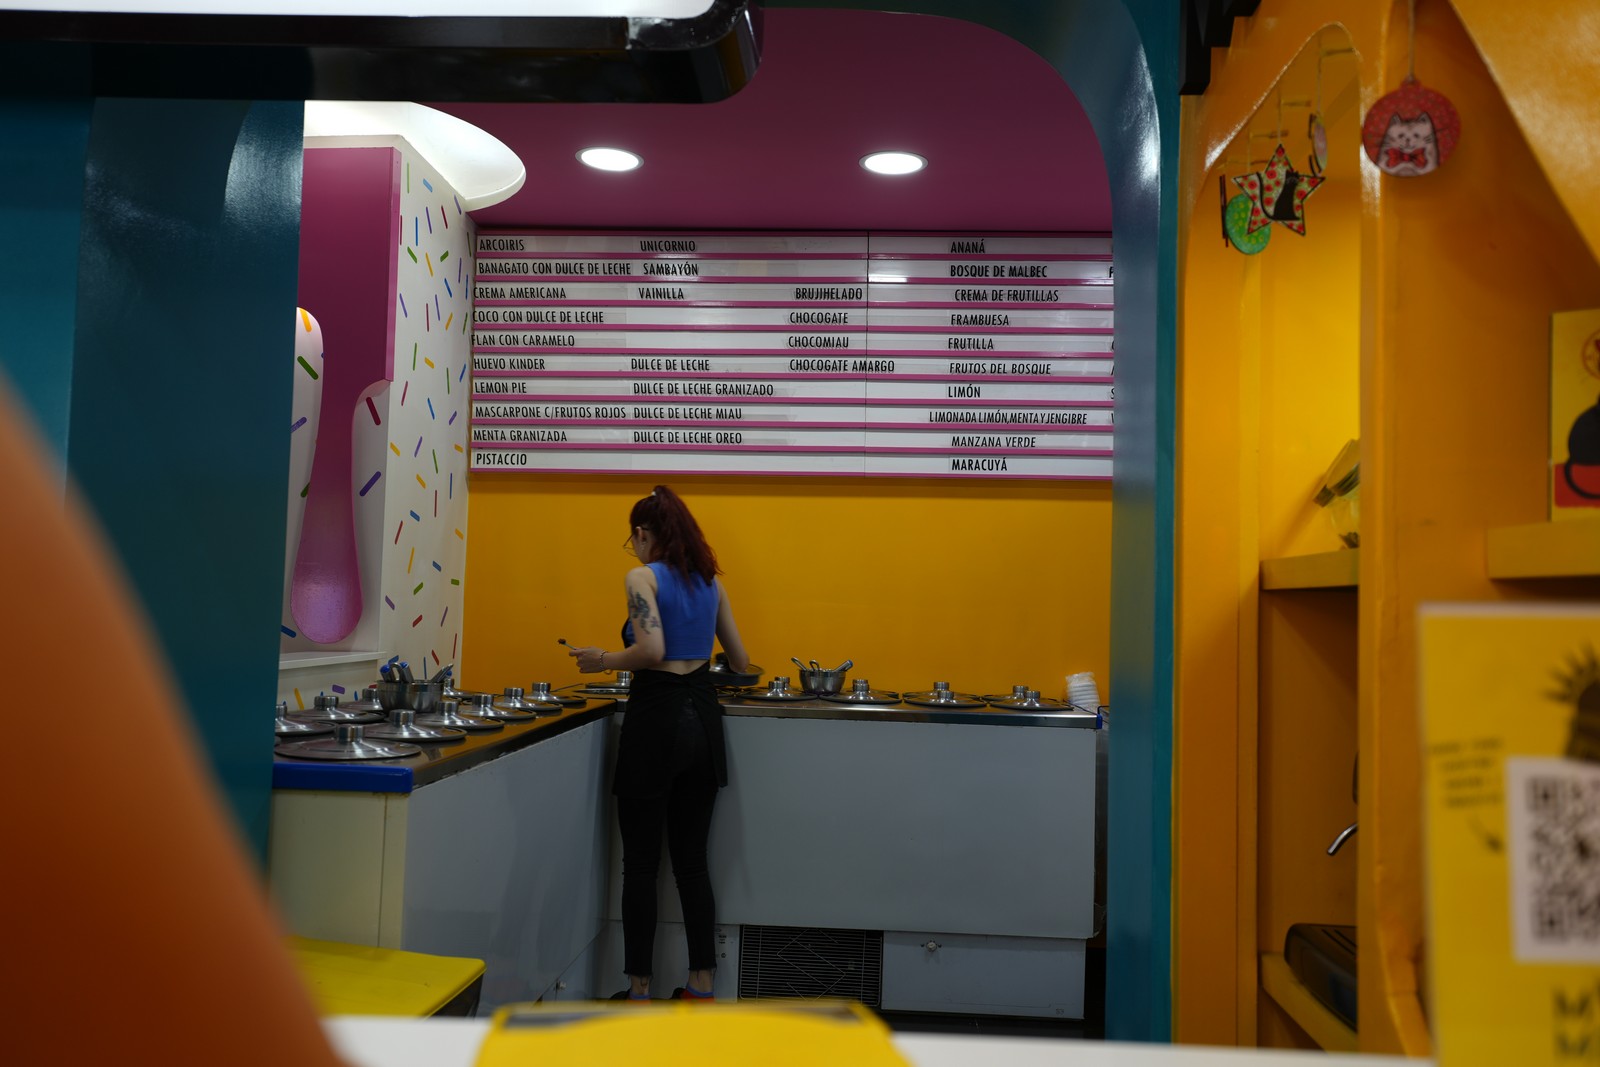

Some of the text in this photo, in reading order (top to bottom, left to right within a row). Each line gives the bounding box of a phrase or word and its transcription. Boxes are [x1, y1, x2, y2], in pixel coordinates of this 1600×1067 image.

[479, 239, 525, 251] ARCOIRIS
[640, 240, 696, 252] UNICORNIO
[950, 238, 986, 254] ANANÁ
[478, 262, 631, 275] BANAGATO CON DULCE DE LECHE
[643, 261, 698, 276] SAMBAYÓN
[950, 265, 1047, 278] BOSQUE DE MALBEC
[473, 287, 566, 299] CREMA AMERICANA
[638, 287, 684, 300] VAINILLA
[795, 288, 863, 300] BRUJIHELADO
[955, 289, 1059, 302] CREMA DE FRUTILLAS
[472, 311, 604, 323] COCO CON DULCE DE LECHE
[789, 312, 848, 325] CHOCOGATE
[951, 314, 1009, 326] FRAMBUESA
[471, 334, 575, 347] FLAN CON CARAMELO
[788, 336, 849, 348] CHOCOMIAU
[948, 337, 994, 350] FRUTILLA
[473, 358, 545, 370] HUEVO KINDER
[631, 358, 710, 371] DULCE DE LECHE
[789, 359, 895, 372] CHOCOGATE AMARGO
[949, 362, 1051, 375] FRUTOS DEL BOSQUE
[475, 381, 527, 394] LEMON PIE
[633, 382, 774, 396] DULCE DE LECHE GRANIZADO
[948, 383, 981, 398] LIMÓN
[475, 406, 626, 420] MASCARPONE C/FRUTOS ROJOS
[633, 407, 742, 420] DULCE DE LECHE MIAU
[929, 411, 977, 423] LIMONADA
[473, 429, 567, 442] MENTA GRANIZADA
[633, 431, 742, 444] DULCE DE LECHE OREO
[951, 435, 1036, 448] MANZANA VERDE
[476, 453, 527, 466] PISTACCIO
[951, 456, 1008, 471] MARACUYÁ
